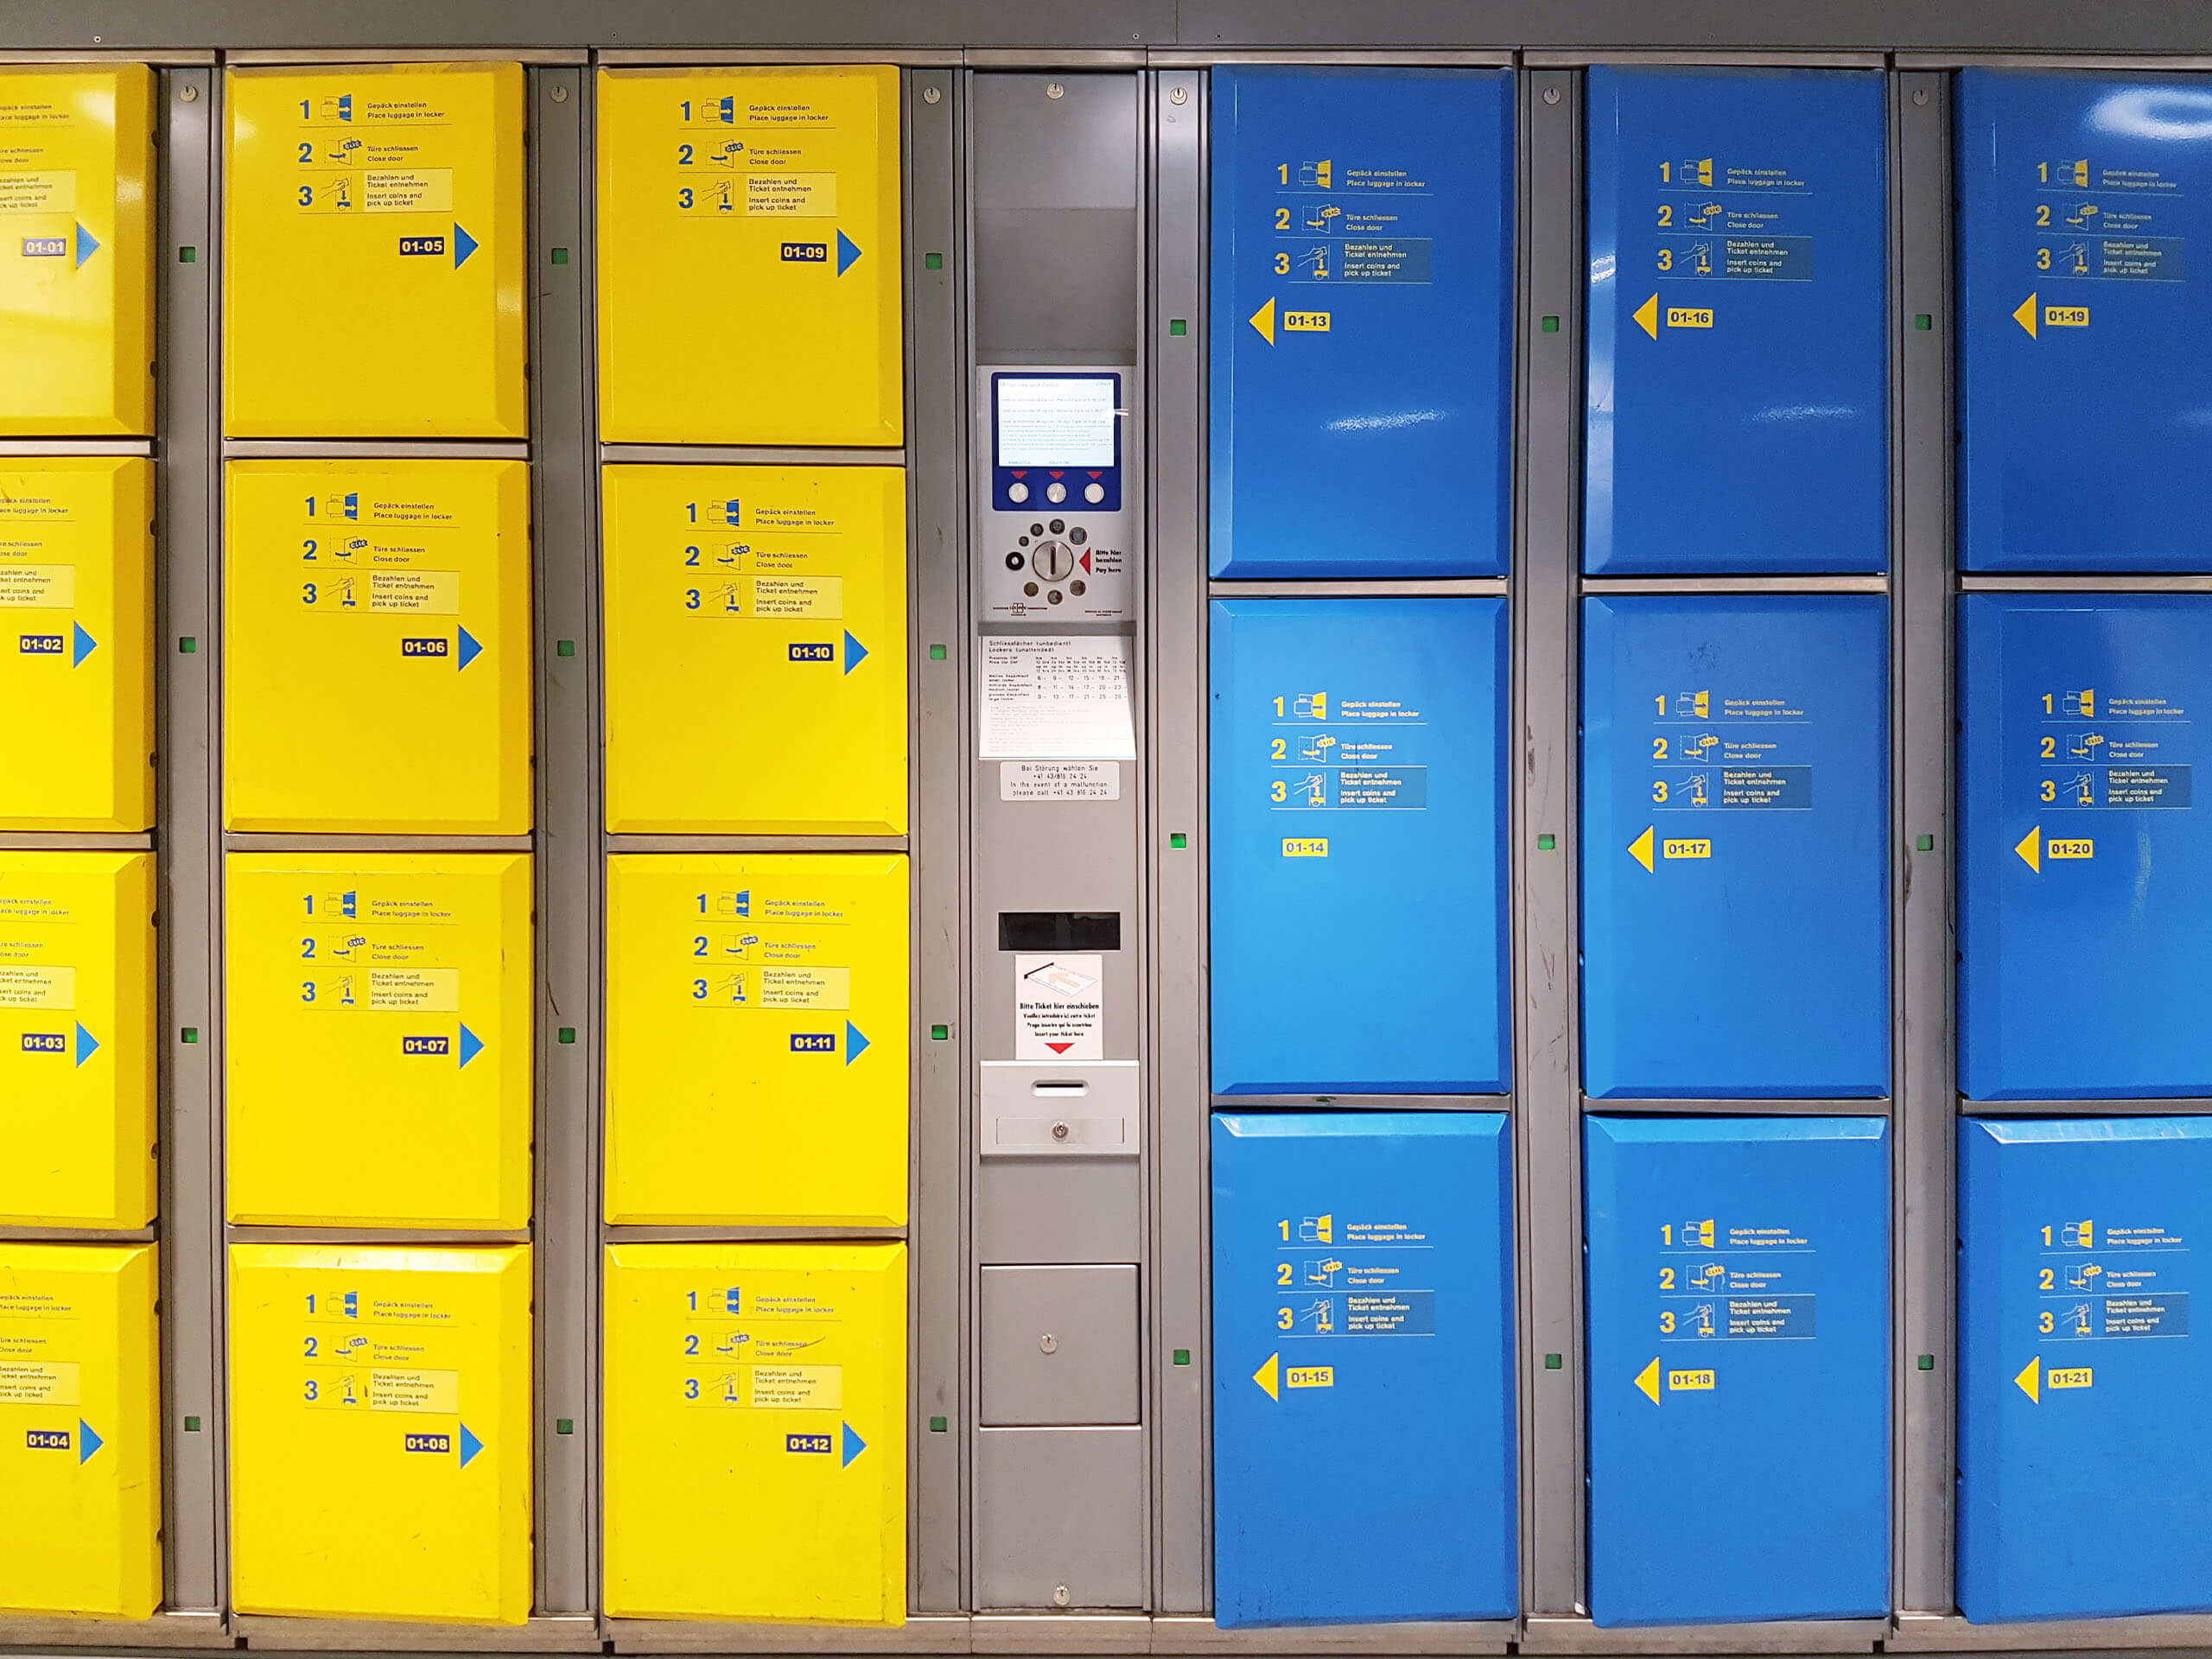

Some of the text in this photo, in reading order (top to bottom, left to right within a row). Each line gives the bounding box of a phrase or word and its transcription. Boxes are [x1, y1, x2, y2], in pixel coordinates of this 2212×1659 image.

[300, 100, 310, 119] 1
[681, 101, 690, 121] 1
[299, 143, 313, 163] 2
[679, 144, 694, 165] 2
[1277, 164, 1287, 184] 1
[1659, 162, 1669, 181] 1
[2037, 162, 2046, 181] 1
[298, 186, 313, 207] 3
[679, 188, 694, 209] 3
[1276, 208, 1289, 229] 2
[1659, 206, 1671, 226] 2
[2037, 206, 2050, 226] 2
[27, 242, 64, 252] 01-01
[402, 241, 442, 252] 01-05
[784, 247, 824, 258] 01-09
[1275, 253, 1289, 274] 3
[1658, 250, 1671, 270] 3
[2037, 249, 2050, 269] 3
[1288, 315, 1327, 327] 01-13
[1671, 313, 1709, 323] 01-16
[2049, 310, 2085, 321] 01-19
[305, 497, 315, 517] 1
[686, 503, 696, 523] 1
[303, 539, 317, 561] 2
[685, 545, 700, 566] 2
[303, 583, 317, 604] 3
[686, 588, 701, 609] 3
[22, 639, 61, 650] 01-02
[404, 642, 446, 653] 01-06
[792, 647, 830, 658] 01-10
[1273, 696, 1284, 716] 1
[1655, 696, 1665, 715] 1
[2042, 694, 2051, 714] 1
[1272, 739, 1286, 759] 2
[1654, 738, 1668, 759] 2
[2042, 737, 2055, 757] 2
[1272, 781, 1286, 802] 3
[1653, 781, 1668, 802] 3
[2041, 781, 2055, 801] 3
[1286, 842, 1325, 852] 01-14
[1669, 843, 1706, 854] 01-17
[2052, 843, 2090, 854] 01-20
[303, 894, 314, 915] 1
[696, 893, 707, 913] 1
[302, 938, 316, 958] 2
[694, 936, 709, 957] 2
[302, 981, 316, 1002] 3
[693, 978, 708, 1000] 3
[24, 1037, 63, 1049] 01-03
[405, 1040, 446, 1052] 01-07
[795, 1038, 831, 1049] 01-11
[1278, 1220, 1288, 1241] 1
[1661, 1225, 1671, 1244] 1
[2041, 1226, 2051, 1246] 1
[1278, 1264, 1292, 1285] 2
[1661, 1268, 1675, 1289] 2
[2040, 1269, 2053, 1289] 2
[306, 1294, 315, 1314] 1
[687, 1291, 696, 1311] 1
[1279, 1308, 1293, 1329] 3
[1661, 1312, 1675, 1333] 3
[2039, 1313, 2053, 1332] 3
[305, 1337, 318, 1357] 2
[685, 1334, 699, 1356] 2
[1292, 1371, 1329, 1382] 01-15
[1673, 1374, 1710, 1384] 01-18
[2053, 1372, 2088, 1384] 01-21
[304, 1380, 318, 1401] 3
[685, 1378, 699, 1400] 3
[29, 1434, 67, 1446] 01-04
[407, 1438, 448, 1450] 01-08
[791, 1438, 829, 1450] 01-12
